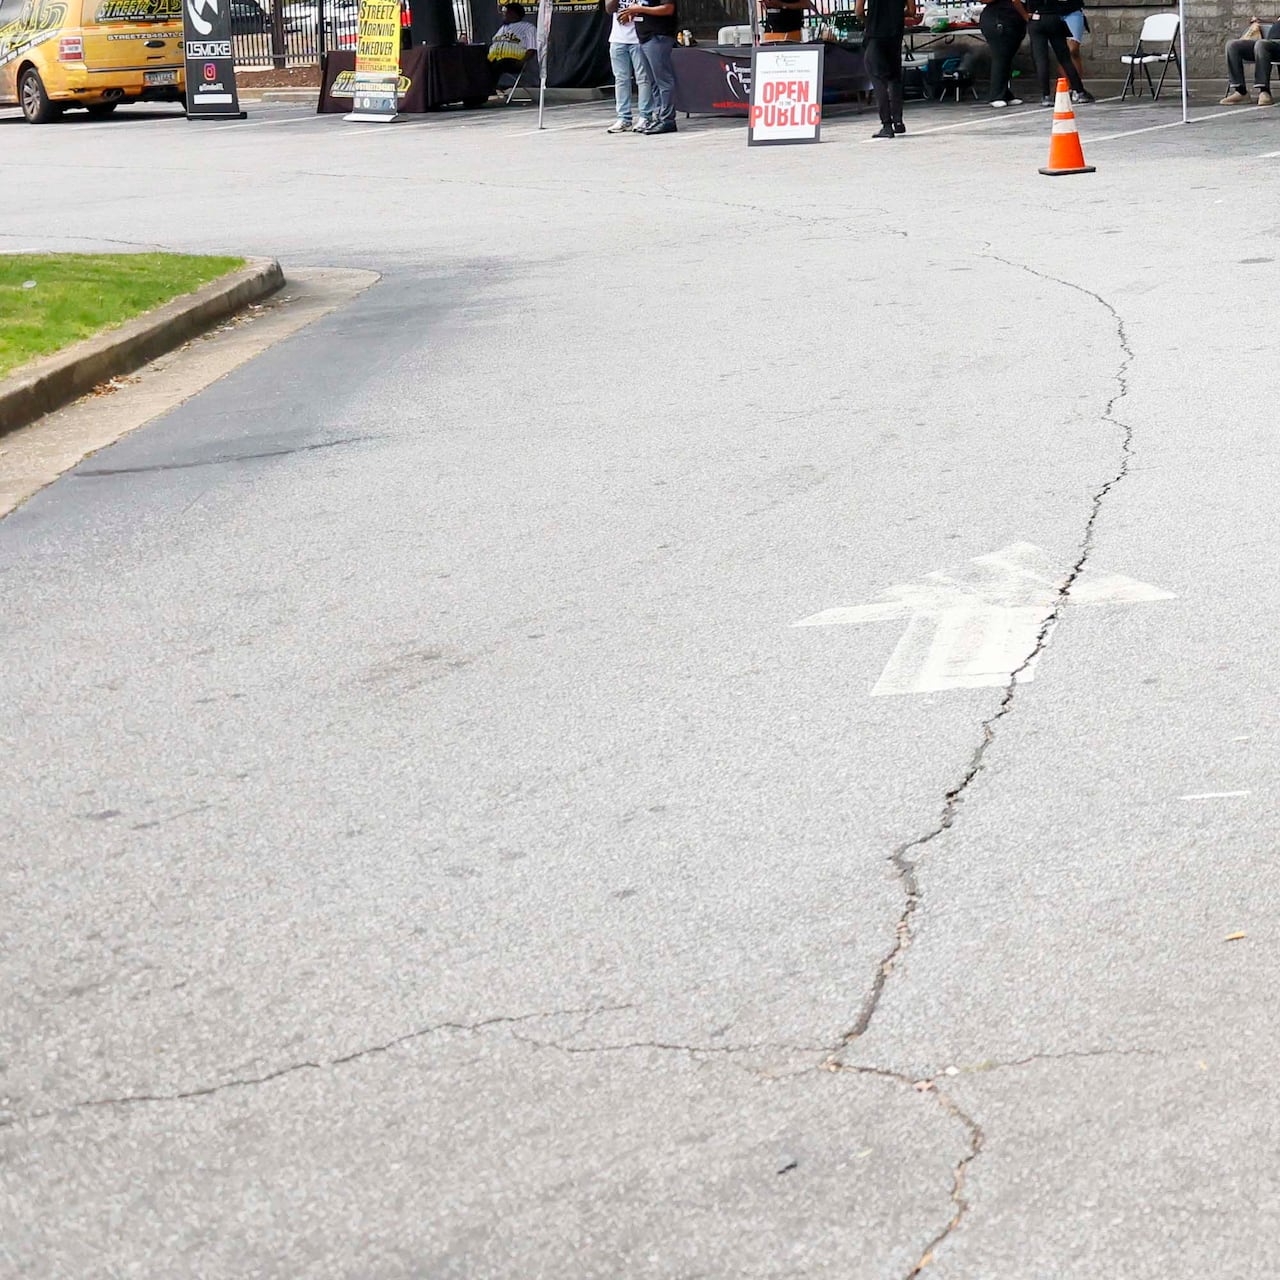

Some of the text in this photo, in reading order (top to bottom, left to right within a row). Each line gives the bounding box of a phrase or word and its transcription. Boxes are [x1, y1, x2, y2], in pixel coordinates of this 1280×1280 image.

[97, 0, 149, 18] STREETZ
[360, 1, 395, 20] STREETZ
[359, 20, 396, 37] MORNING
[357, 36, 394, 56] TAKEOVER
[762, 81, 810, 104] OPEN
[750, 104, 822, 128] PUBLIC
